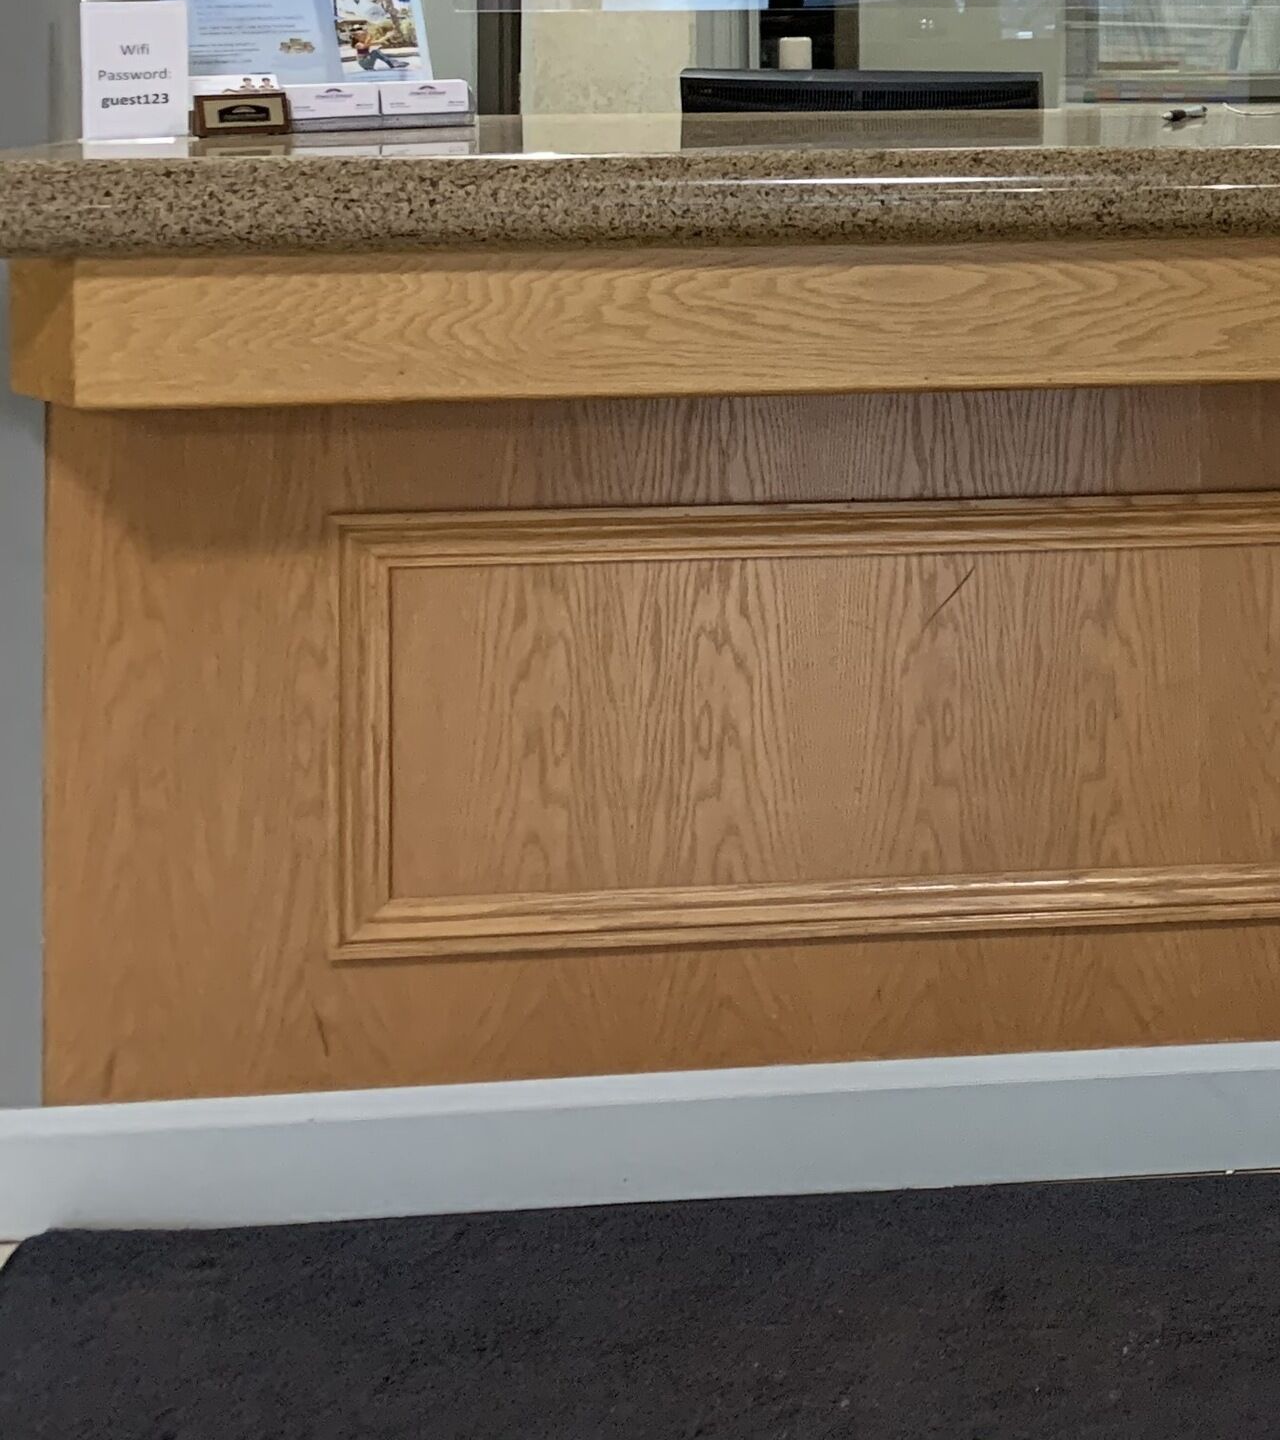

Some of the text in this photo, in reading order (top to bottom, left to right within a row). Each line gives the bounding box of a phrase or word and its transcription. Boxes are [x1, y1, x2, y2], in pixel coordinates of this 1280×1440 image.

[120, 43, 150, 55] Wifi
[98, 68, 171, 80] Password:
[101, 93, 169, 108] guest123
